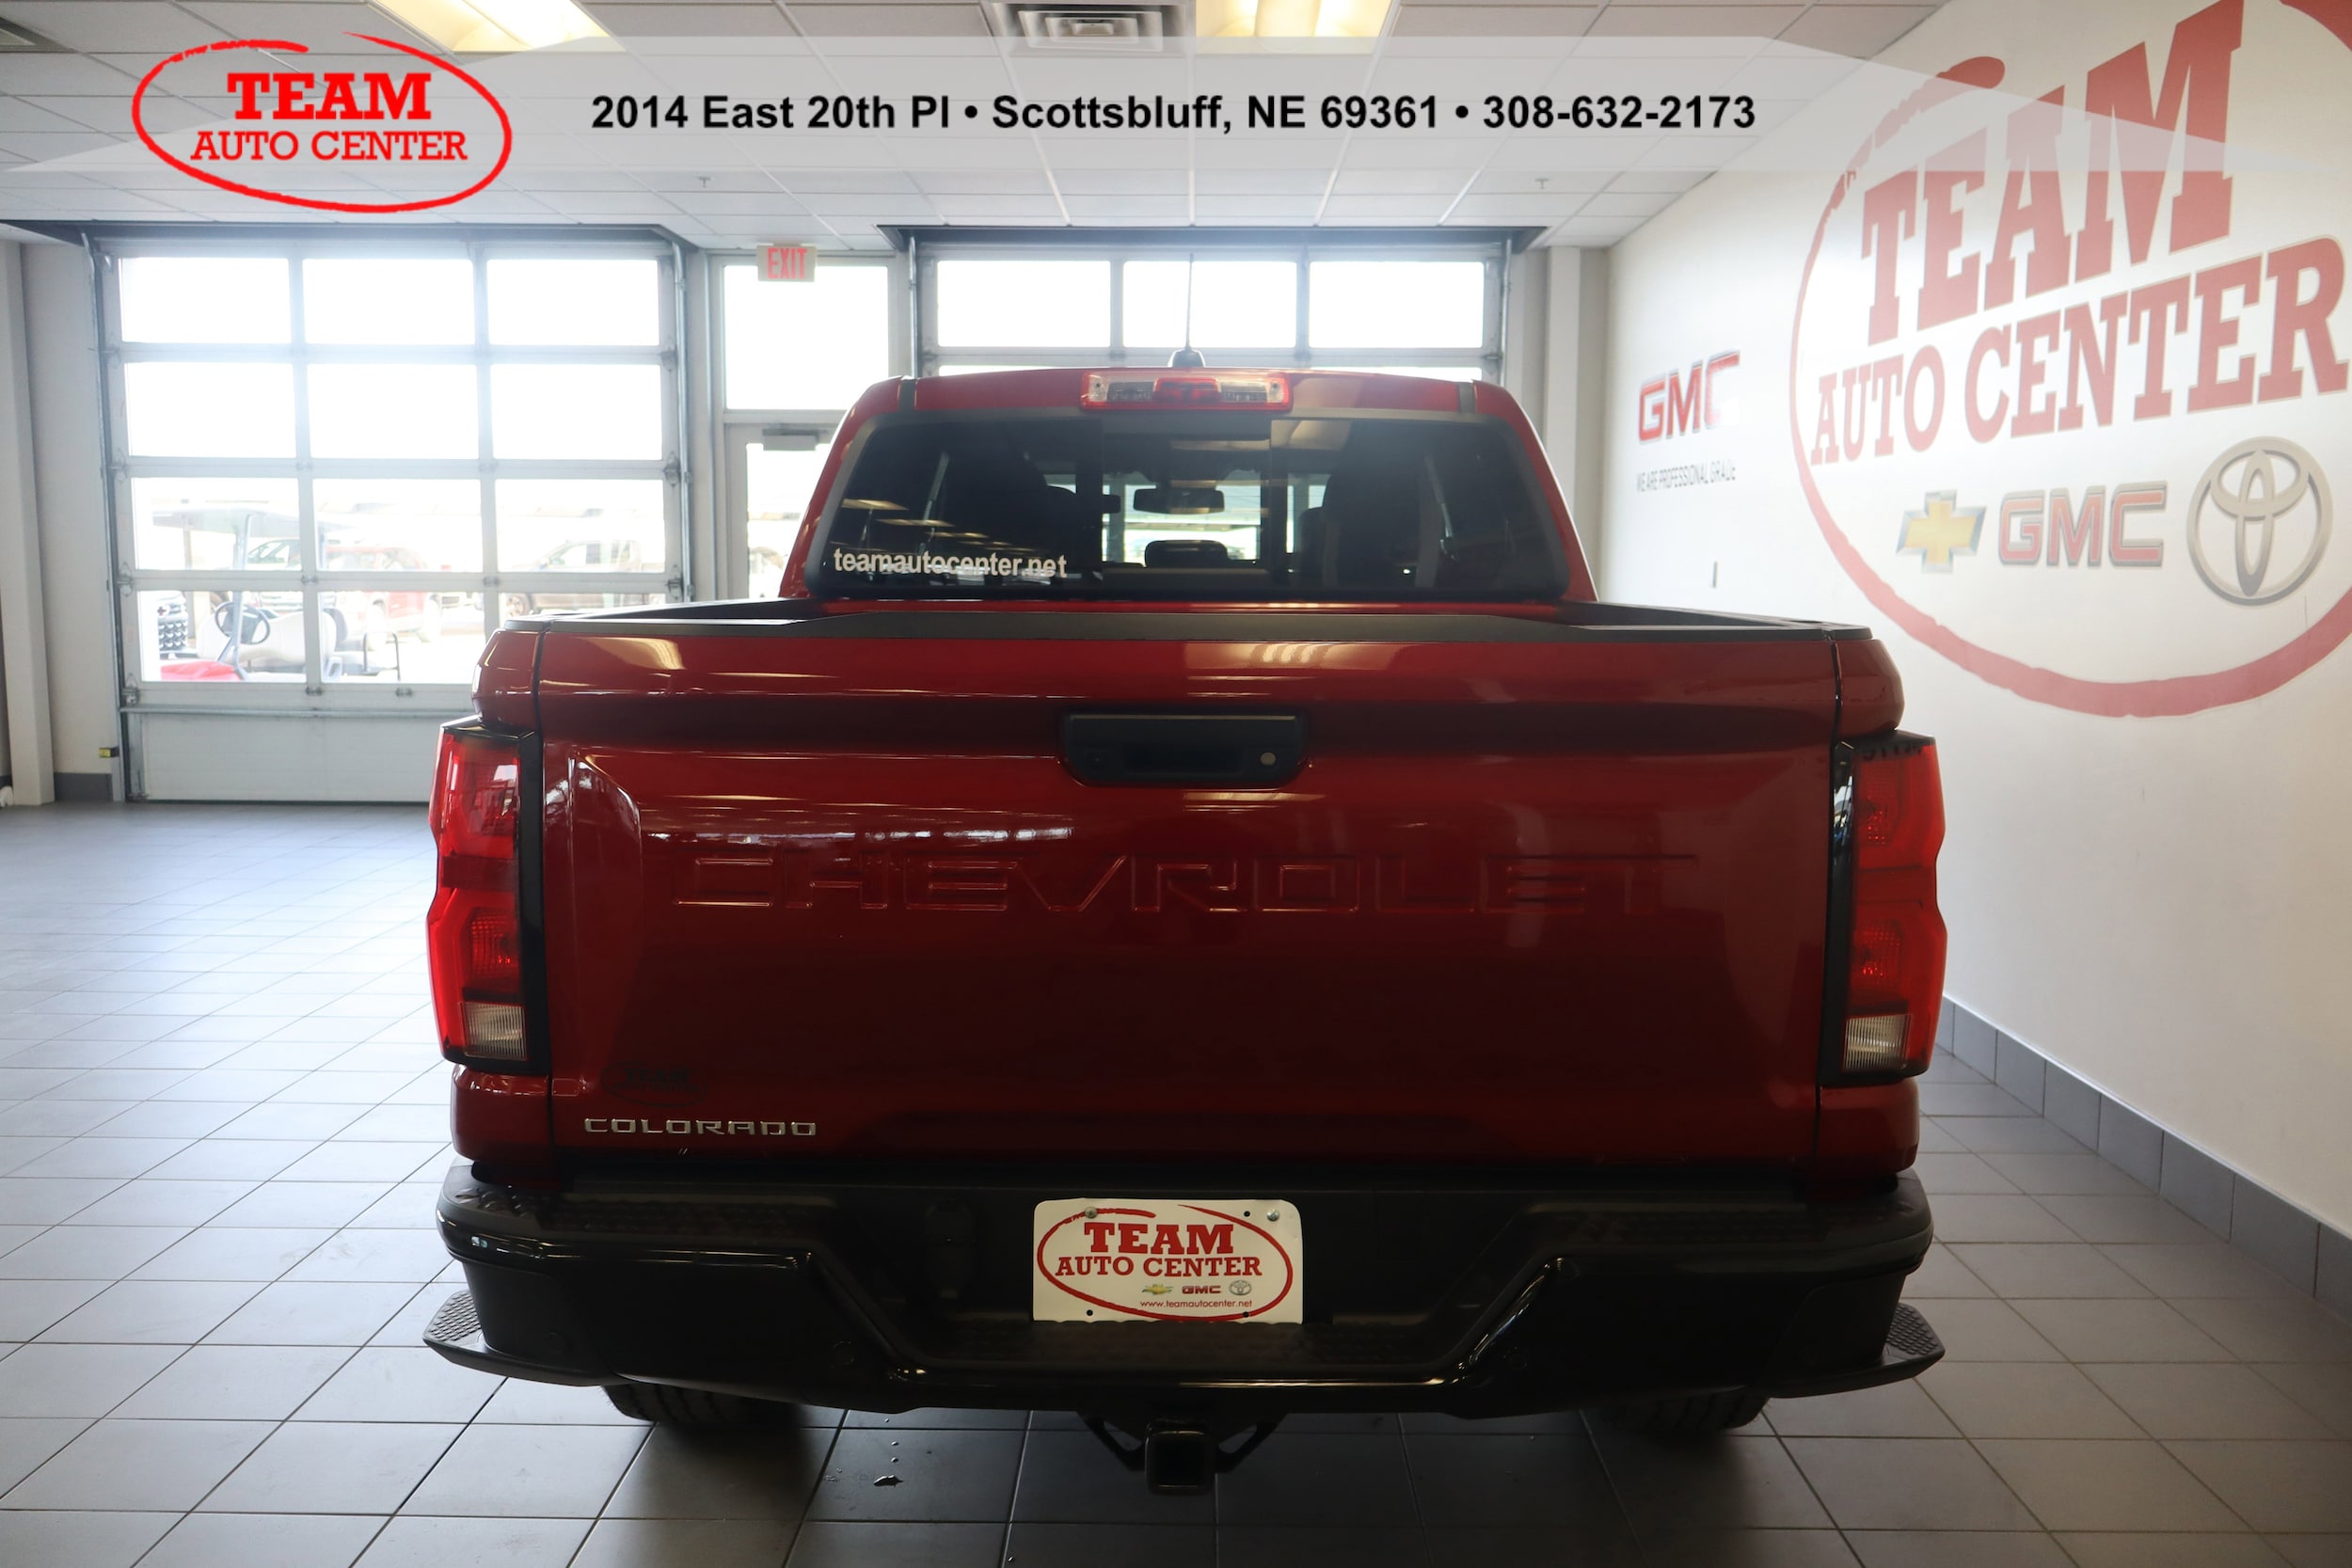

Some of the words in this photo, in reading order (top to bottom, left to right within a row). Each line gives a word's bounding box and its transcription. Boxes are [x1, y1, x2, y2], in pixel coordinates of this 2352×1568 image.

[1862, 0, 2245, 346] TEAM
[767, 246, 808, 279] EXIT
[1810, 344, 1945, 466] AUTO
[1964, 235, 2348, 444] CENTER
[1638, 348, 1740, 445] GMC
[1998, 480, 2168, 566] GMC
[834, 547, 1068, 579] teamautocenter.net
[674, 850, 1699, 914] CHEVROLET
[584, 1117, 817, 1136] COLORADO
[1084, 1222, 1234, 1255] TEAM
[1055, 1256, 1135, 1276] AUTO
[1143, 1257, 1263, 1277] CENTER
[1139, 1299, 1253, 1308] www.teamautocenter.net
[1182, 1285, 1222, 1294] GMC
